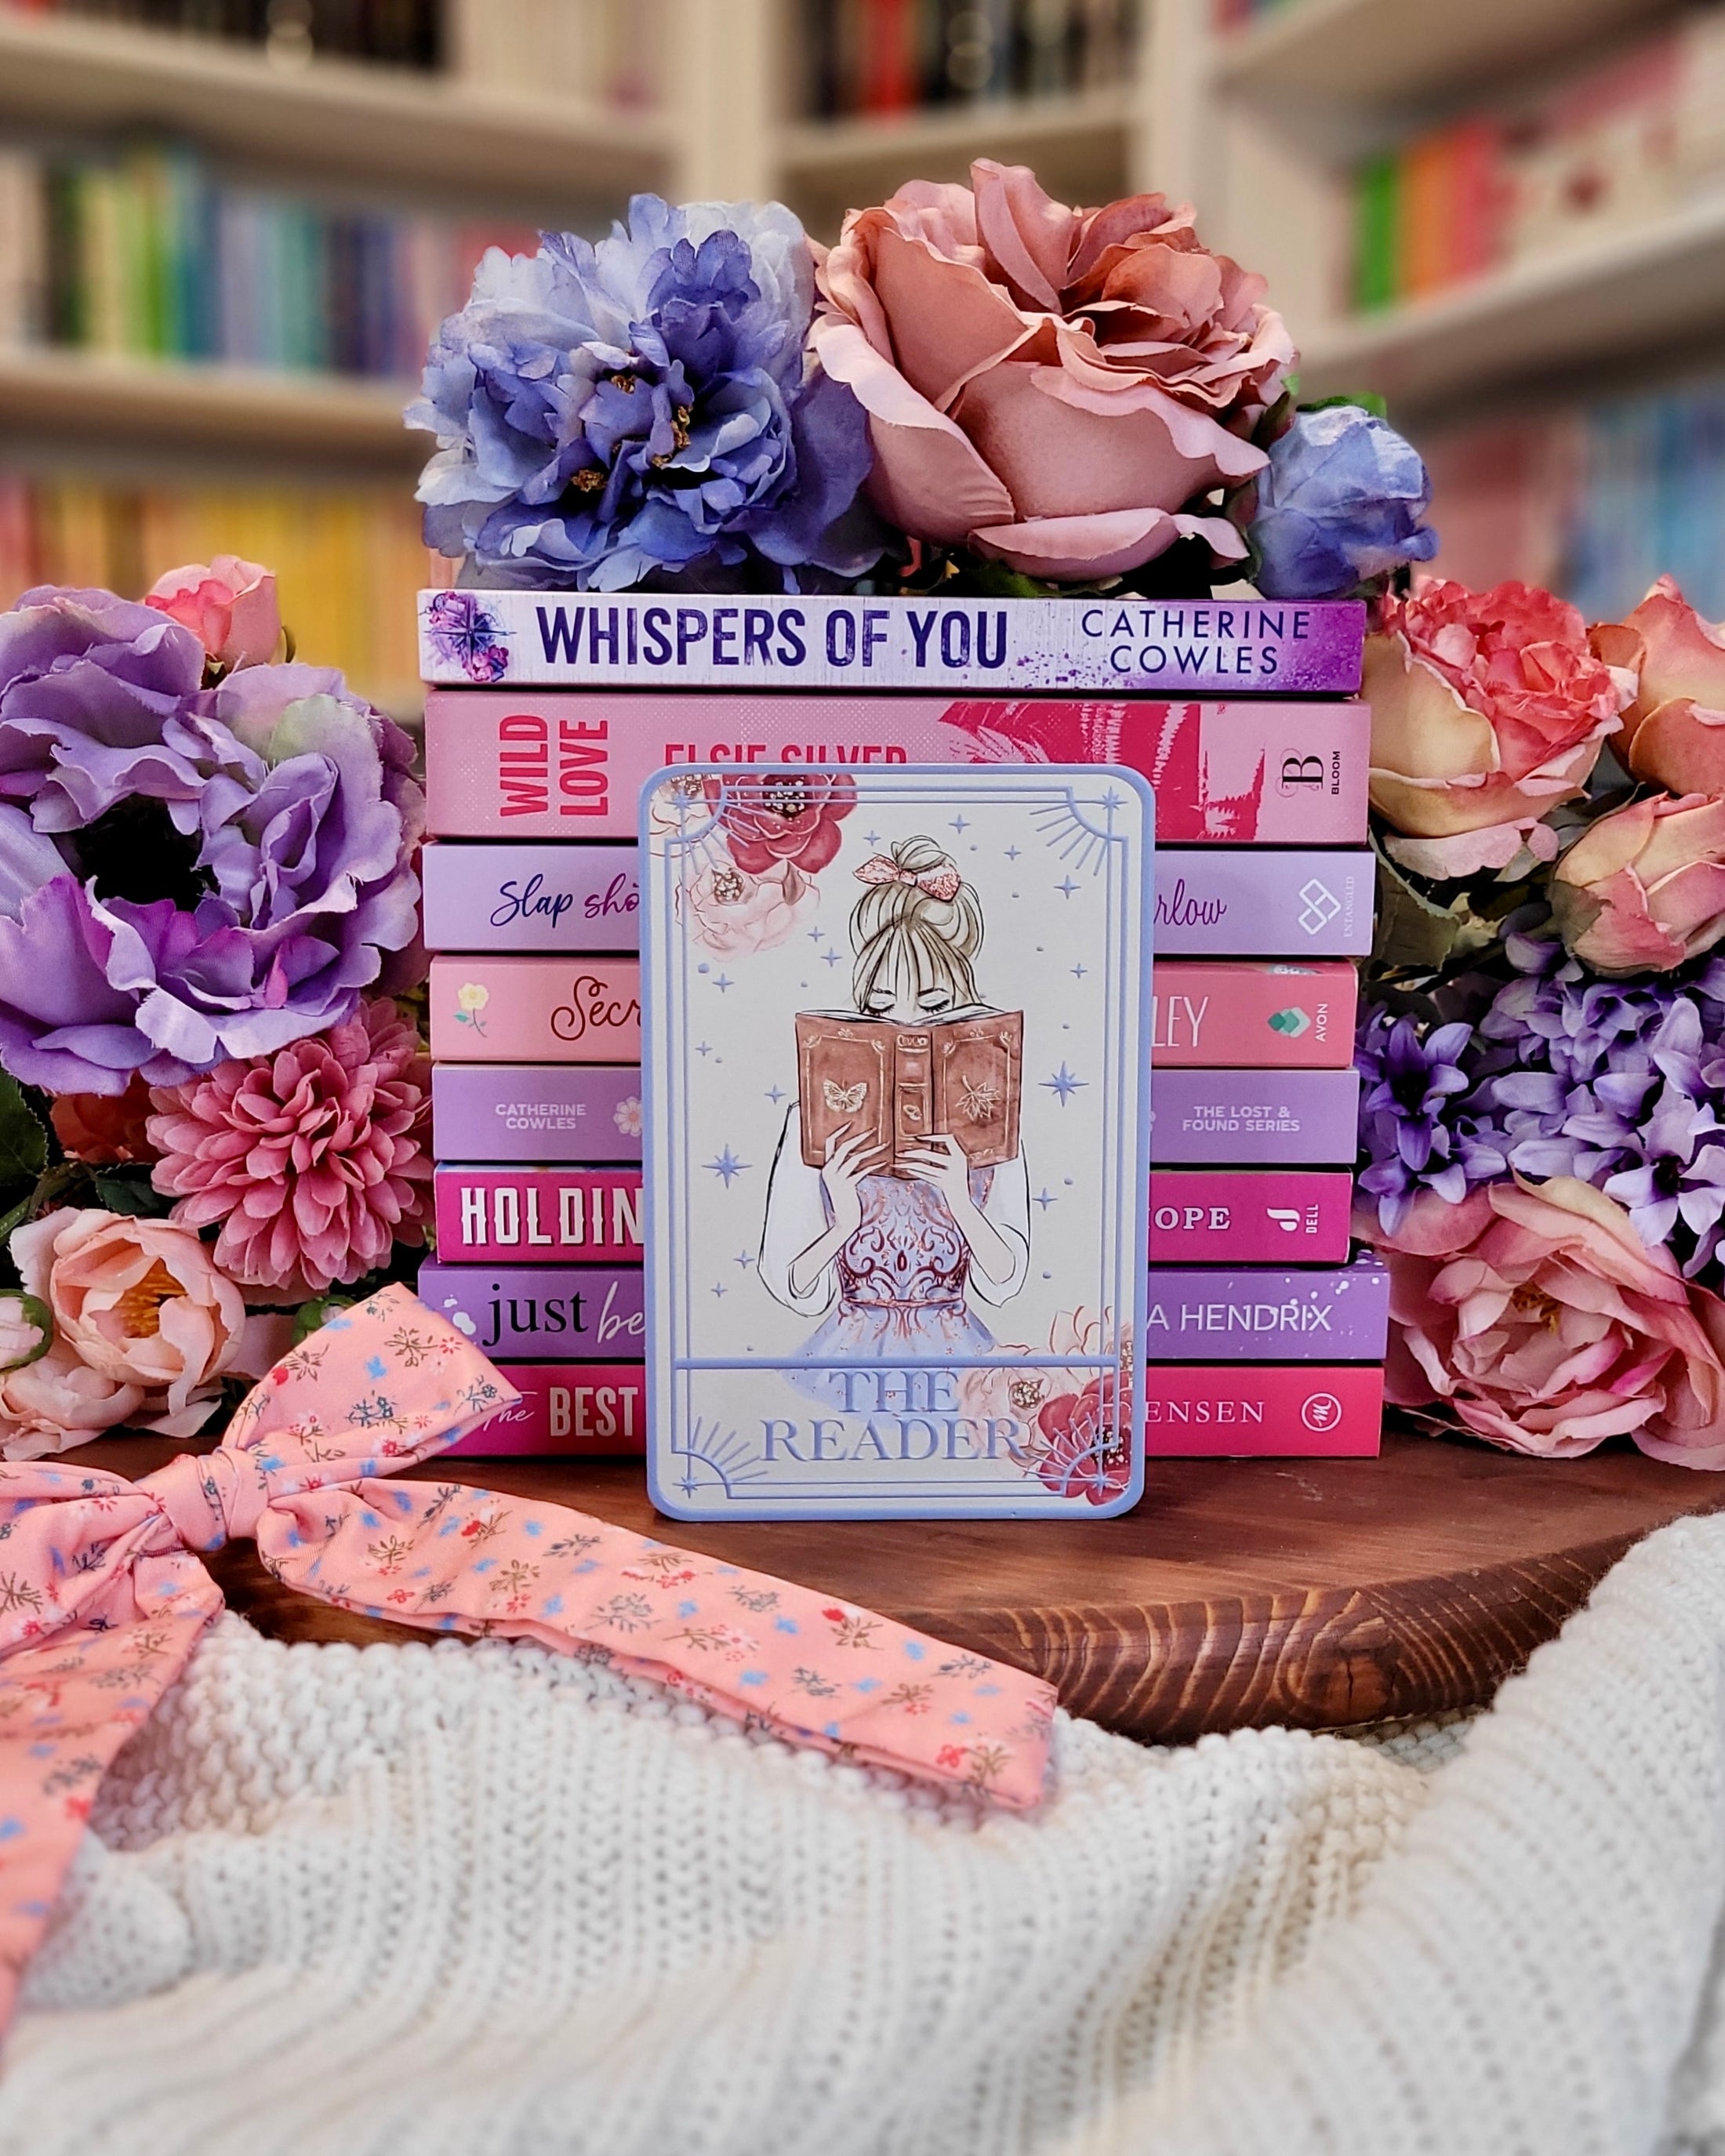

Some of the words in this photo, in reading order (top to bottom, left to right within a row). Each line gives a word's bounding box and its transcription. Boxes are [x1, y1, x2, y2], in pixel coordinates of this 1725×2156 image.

[536, 606, 806, 666] WHISPERS
[826, 609, 890, 667] OF
[906, 610, 1008, 669] YOU
[1081, 608, 1309, 640] CATHERINE
[1109, 645, 1279, 675] COWLES
[499, 714, 549, 817] WILD
[559, 719, 608, 816] LOVE
[1331, 751, 1340, 794] BLOOM
[490, 873, 573, 928] Slap
[584, 873, 640, 919] sho
[1314, 1003, 1327, 1042] AVON
[495, 1103, 586, 1116] CATHERINE
[506, 1117, 576, 1130] COWLES
[1182, 1119, 1240, 1131] FOUND
[1245, 1119, 1301, 1131] SERIES
[1193, 1105, 1225, 1117] THE
[1230, 1105, 1273, 1118] LOST
[1277, 1105, 1291, 1118] &
[1148, 1207, 1231, 1229] OPE
[1306, 1203, 1319, 1234] DELL
[482, 1283, 589, 1347] just
[1180, 1304, 1333, 1331] HENDRIX
[829, 1370, 960, 1413] THE
[550, 1386, 639, 1437] BEST
[760, 1418, 1034, 1462] READER
